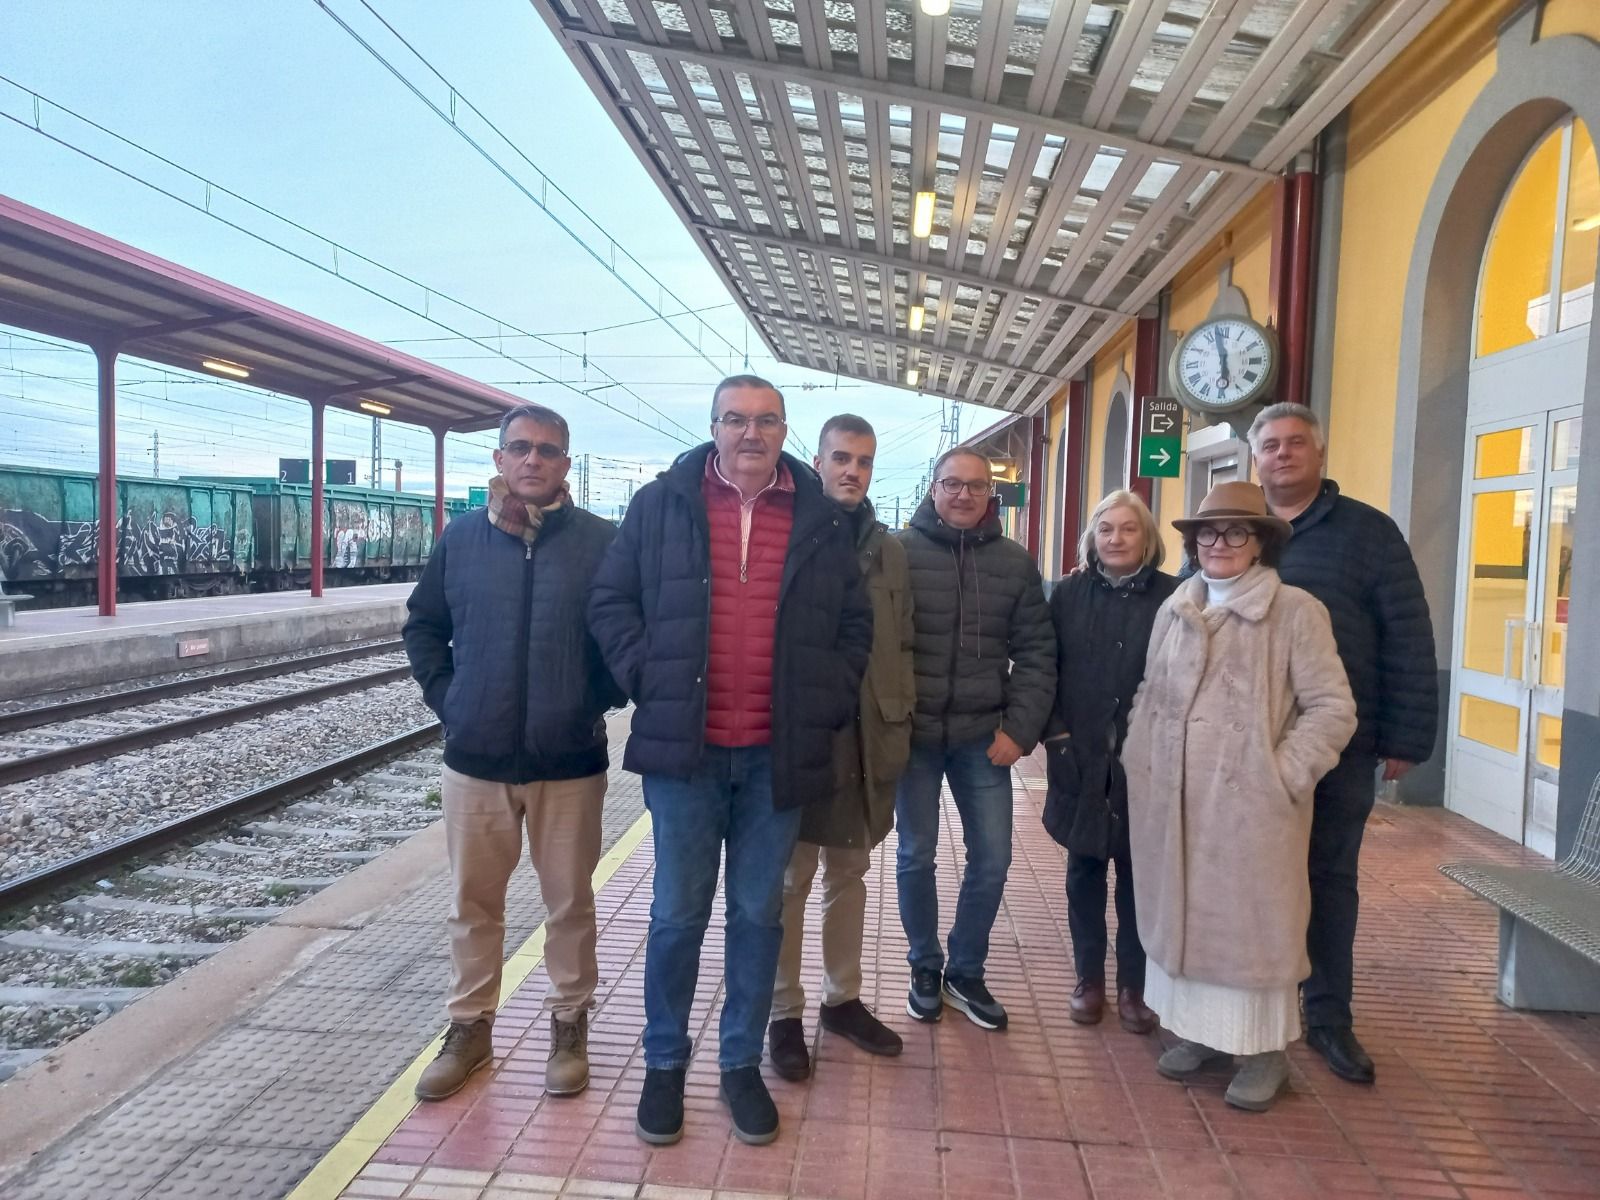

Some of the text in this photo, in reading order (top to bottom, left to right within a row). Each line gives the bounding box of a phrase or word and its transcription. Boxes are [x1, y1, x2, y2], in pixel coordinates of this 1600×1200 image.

[1149, 401, 1177, 411] Salida
[281, 470, 287, 482] 2
[347, 472, 354, 483] 1
